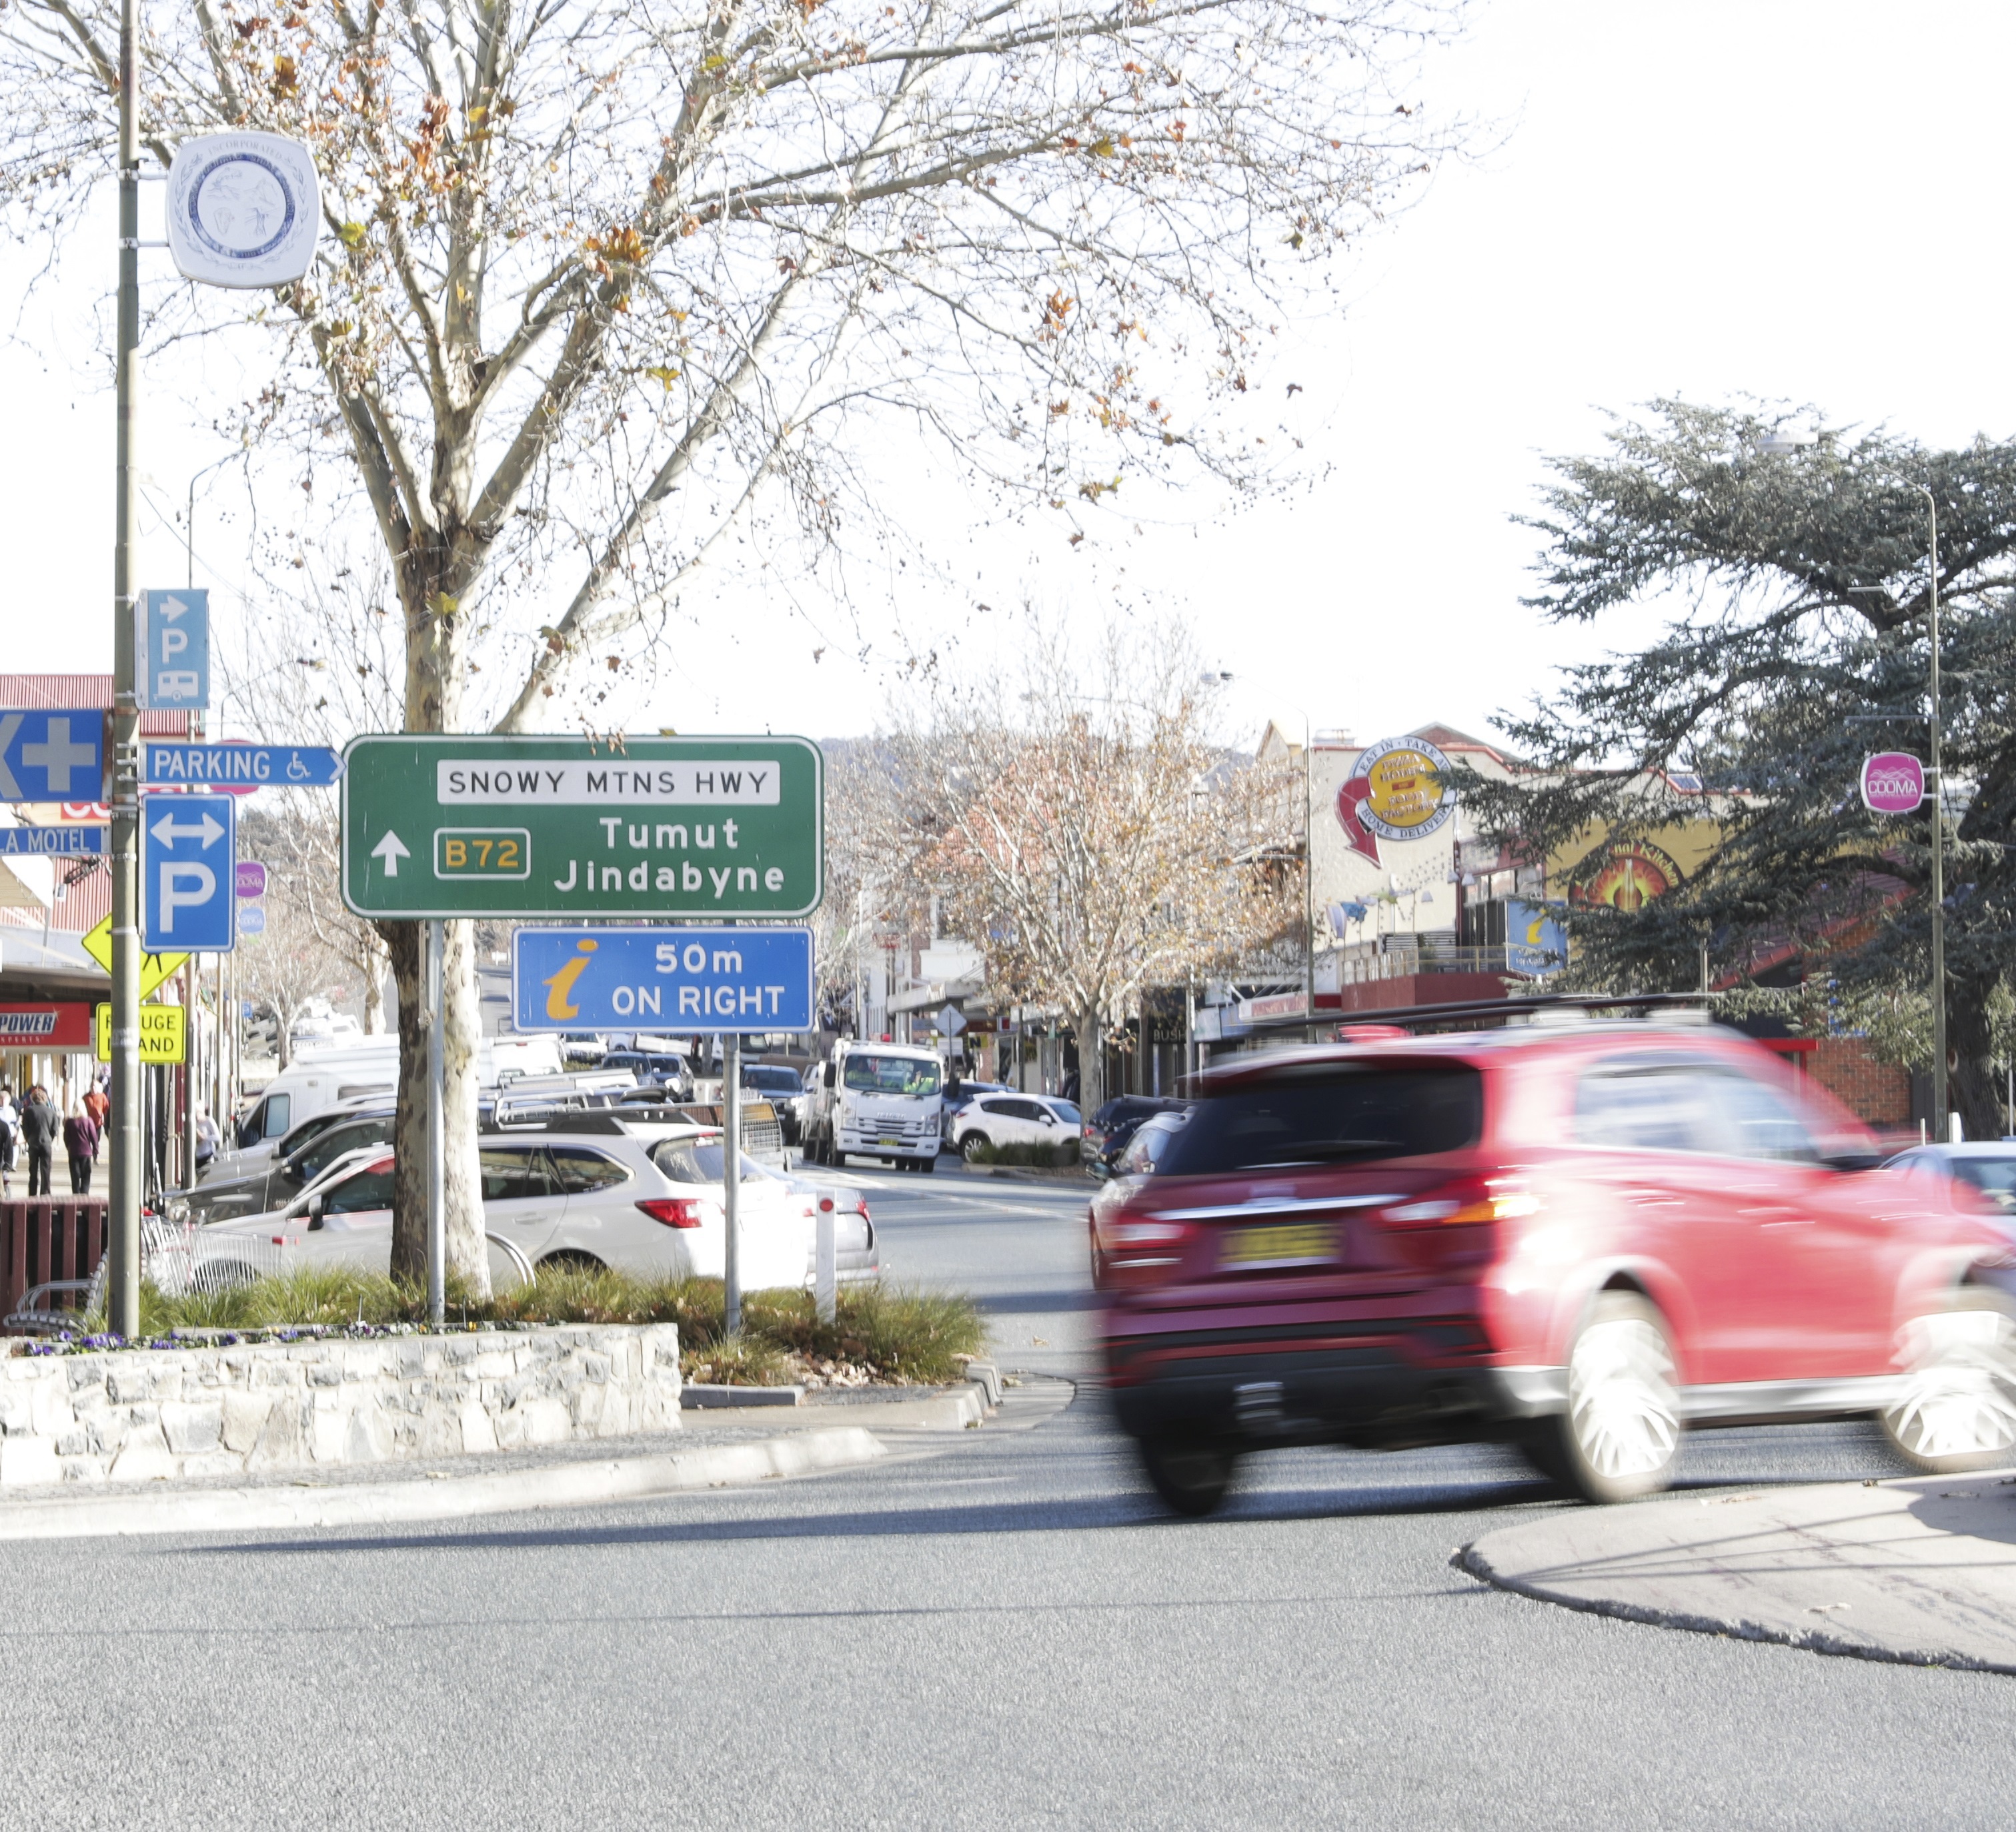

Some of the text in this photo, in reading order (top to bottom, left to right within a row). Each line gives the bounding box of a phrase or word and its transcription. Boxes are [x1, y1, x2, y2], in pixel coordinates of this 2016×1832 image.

[161, 628, 188, 664] P
[155, 750, 270, 780] PARKING
[1360, 751, 1377, 772] EAT
[1381, 741, 1393, 752] IN
[1405, 738, 1437, 757] TAKE
[449, 770, 768, 795] SNOWY MTNS HWY
[1868, 780, 1918, 796] COOMA
[1381, 798, 1440, 820] FACTORY
[1388, 790, 1424, 806] FOOD
[600, 817, 738, 849] Tumut
[1362, 808, 1447, 838] HOME DELIVER
[28, 829, 90, 852] MOTEL
[445, 839, 518, 868] B72
[554, 860, 784, 900] Jindabyne
[159, 862, 217, 933] P
[656, 944, 742, 974] 50m
[612, 985, 785, 1015] ON RIGHT
